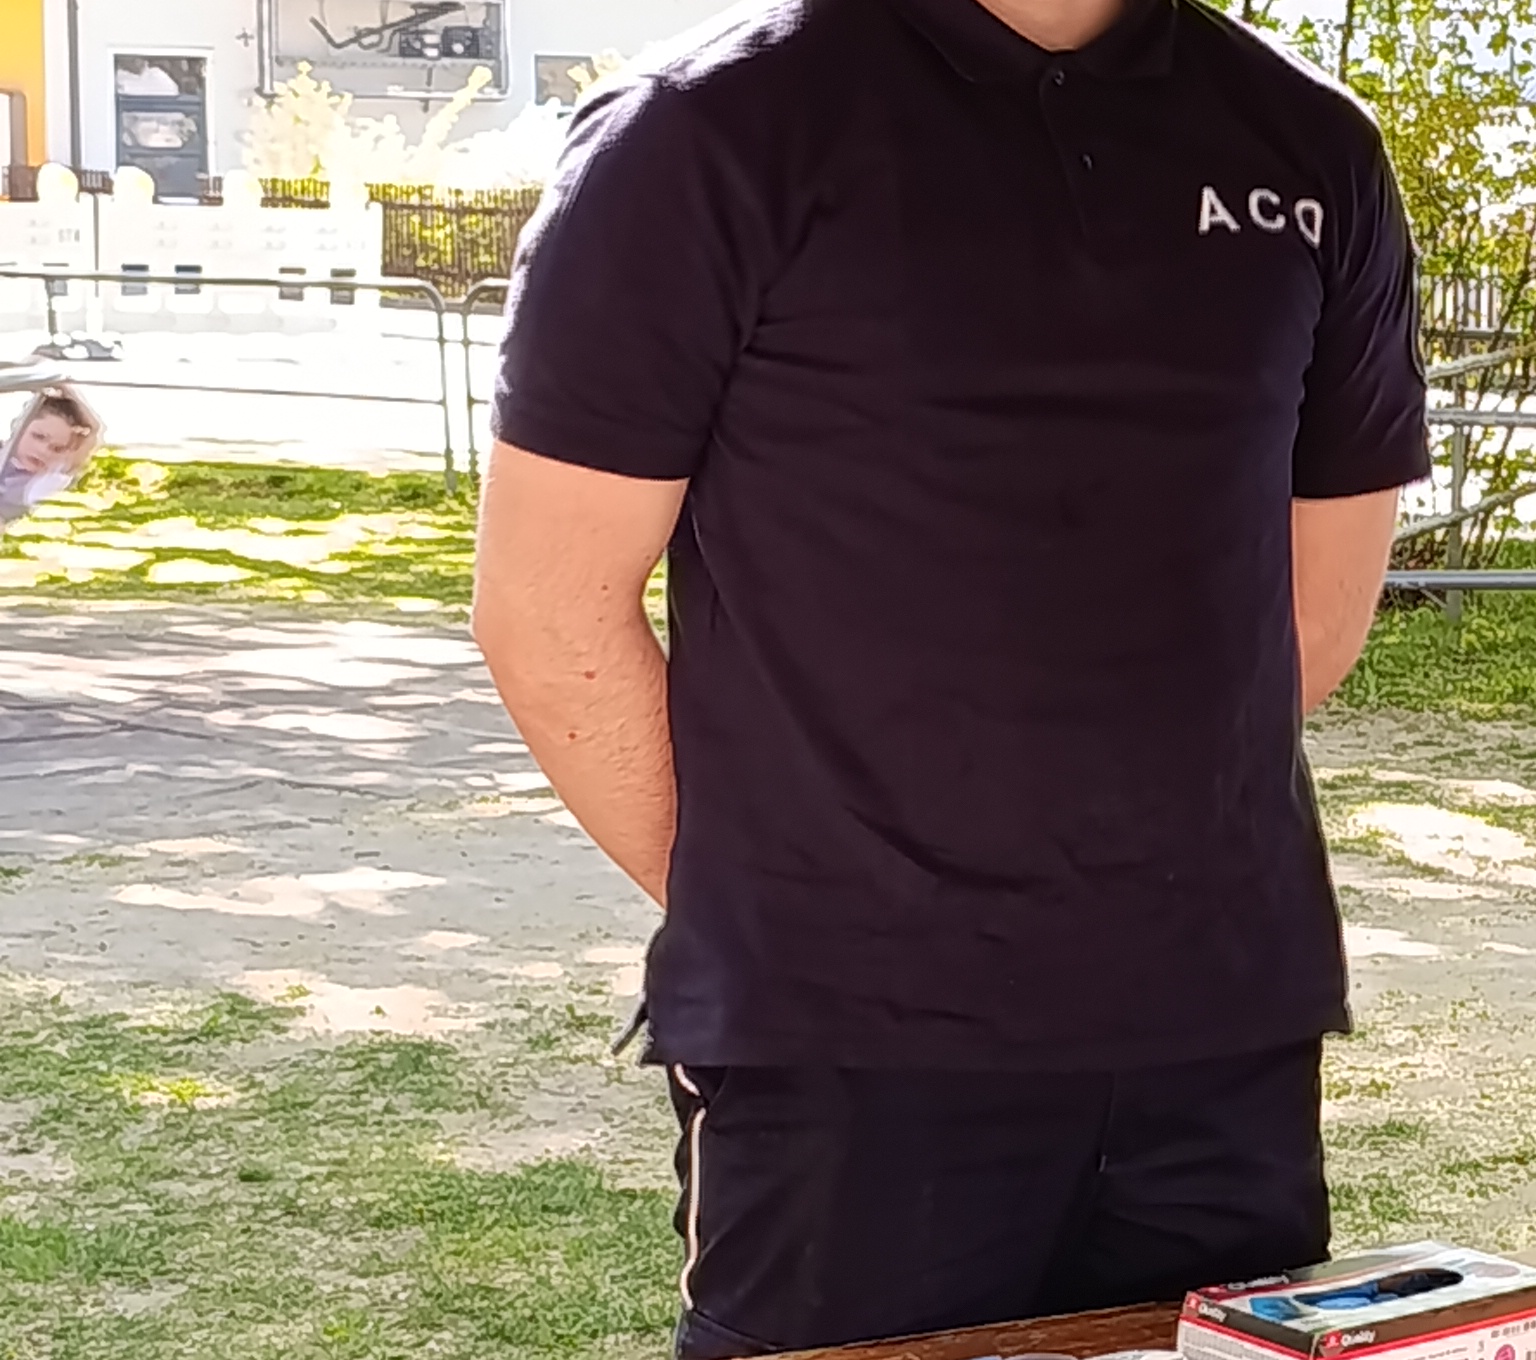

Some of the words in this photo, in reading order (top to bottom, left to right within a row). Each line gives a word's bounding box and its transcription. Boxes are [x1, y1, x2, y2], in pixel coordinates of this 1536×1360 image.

[1198, 185, 1324, 250] ACO
[1199, 1302, 1227, 1322] Quality
[1340, 1329, 1376, 1347] Quality
